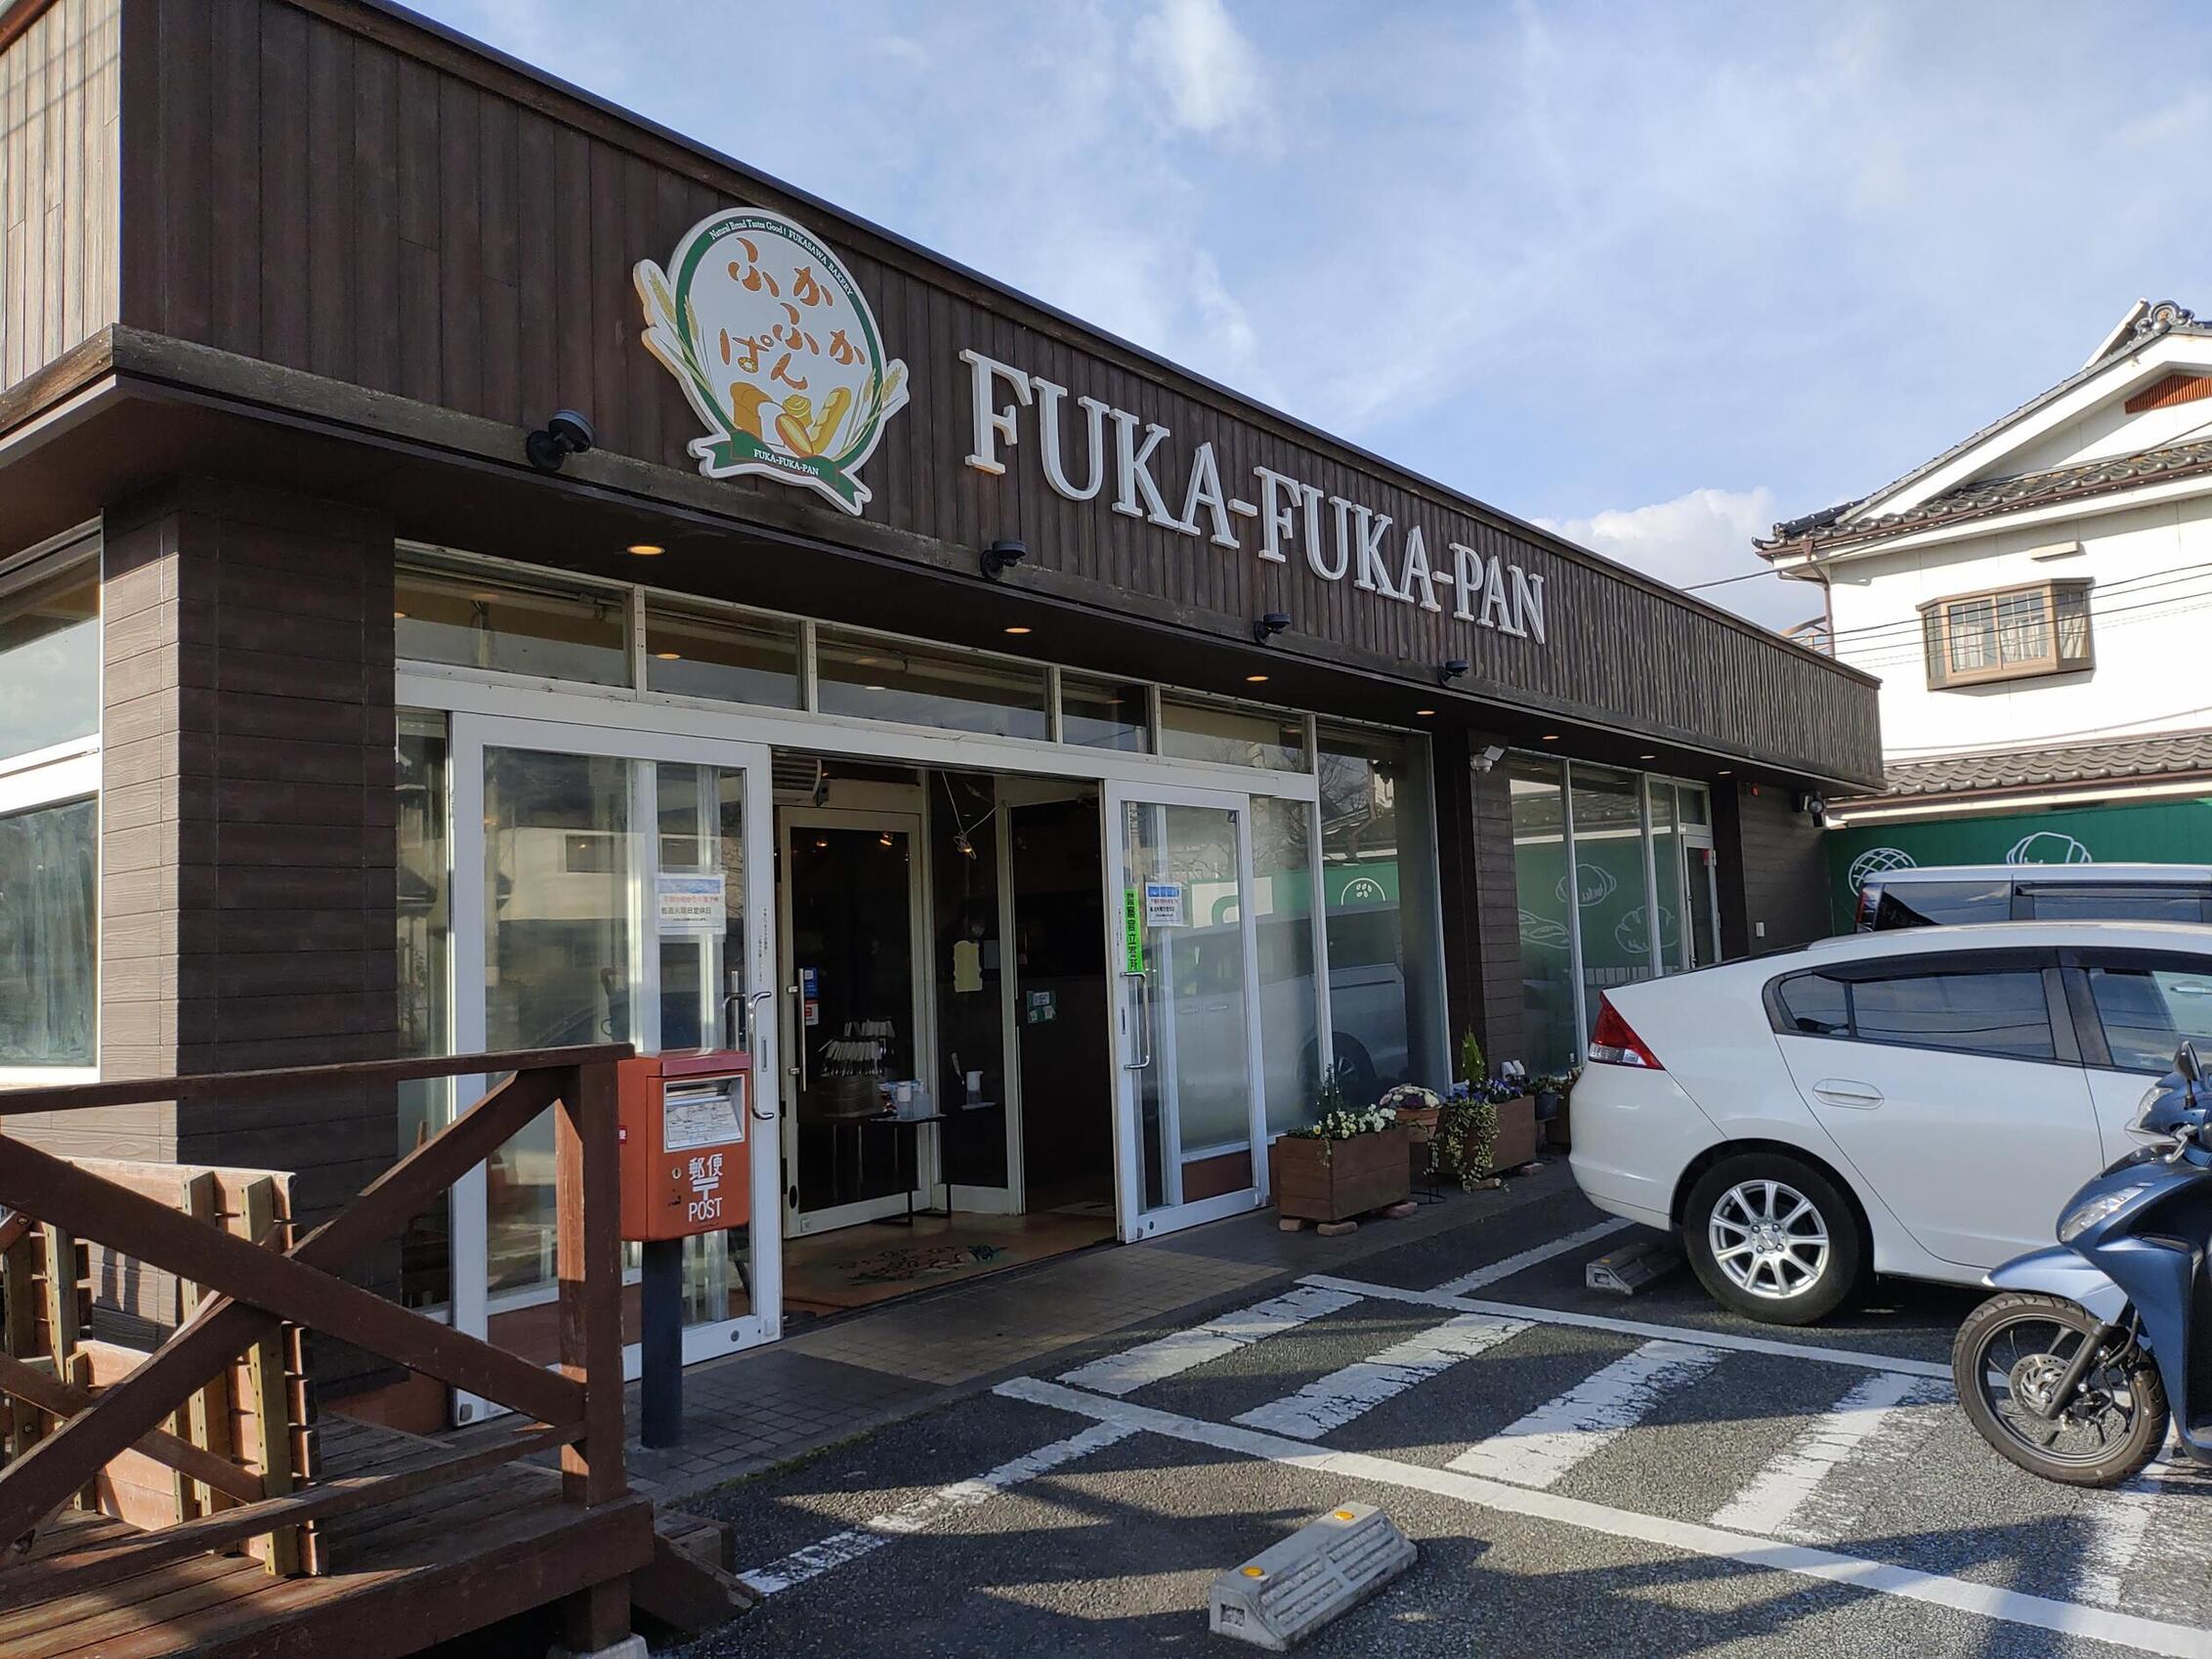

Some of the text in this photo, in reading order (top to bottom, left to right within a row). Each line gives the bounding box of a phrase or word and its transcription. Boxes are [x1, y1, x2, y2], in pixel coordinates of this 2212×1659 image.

[709, 224, 730, 240] Natural
[788, 230, 828, 265] FUKASAWA
[828, 263, 854, 295] BAKERY
[753, 448, 820, 477] FUKA-FUKA-PAN
[958, 349, 1546, 646] FUKA-FUKA-PAN
[689, 1153, 723, 1180] 郵便
[688, 1197, 723, 1222] POST
